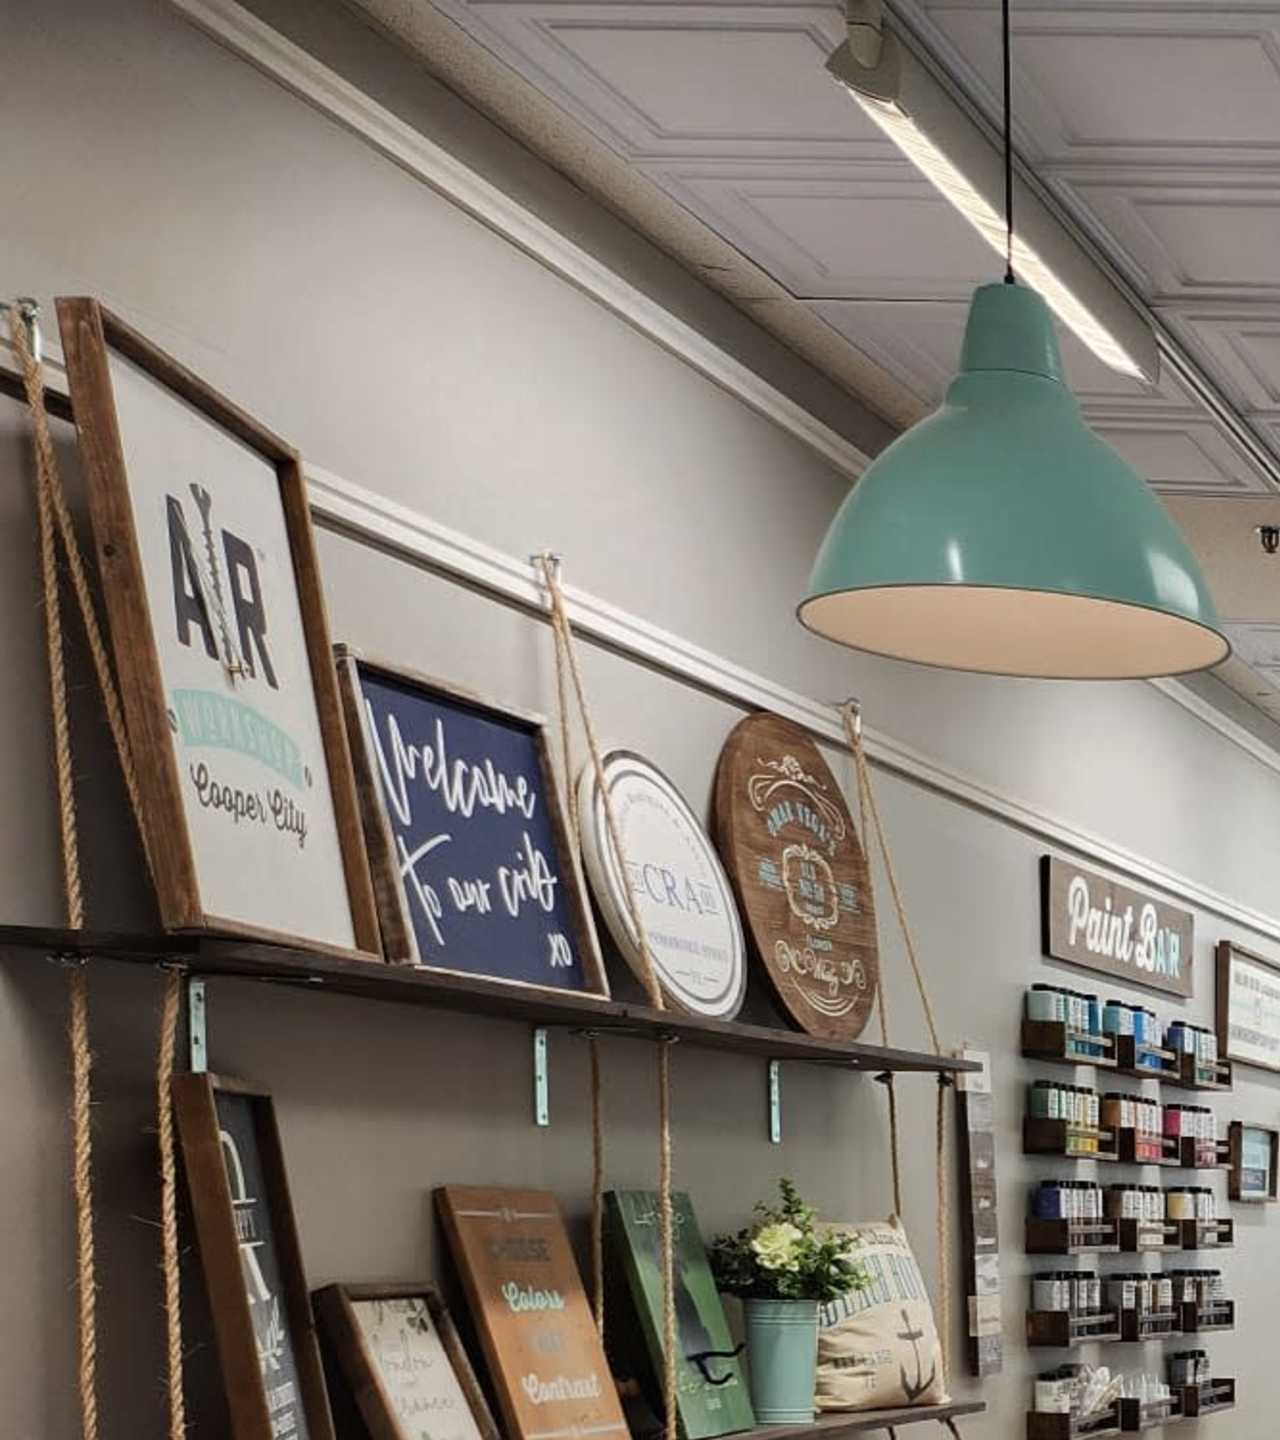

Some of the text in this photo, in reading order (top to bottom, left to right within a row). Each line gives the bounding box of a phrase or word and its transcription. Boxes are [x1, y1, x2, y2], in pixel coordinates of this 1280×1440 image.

[365, 698, 536, 826] Welcome
[191, 763, 308, 849] Cooper City
[449, 876, 492, 914] our
[498, 831, 558, 918] crib
[1068, 875, 1135, 963] Paint
[502, 1281, 565, 1312] Colors
[522, 1371, 601, 1405] Contrast
